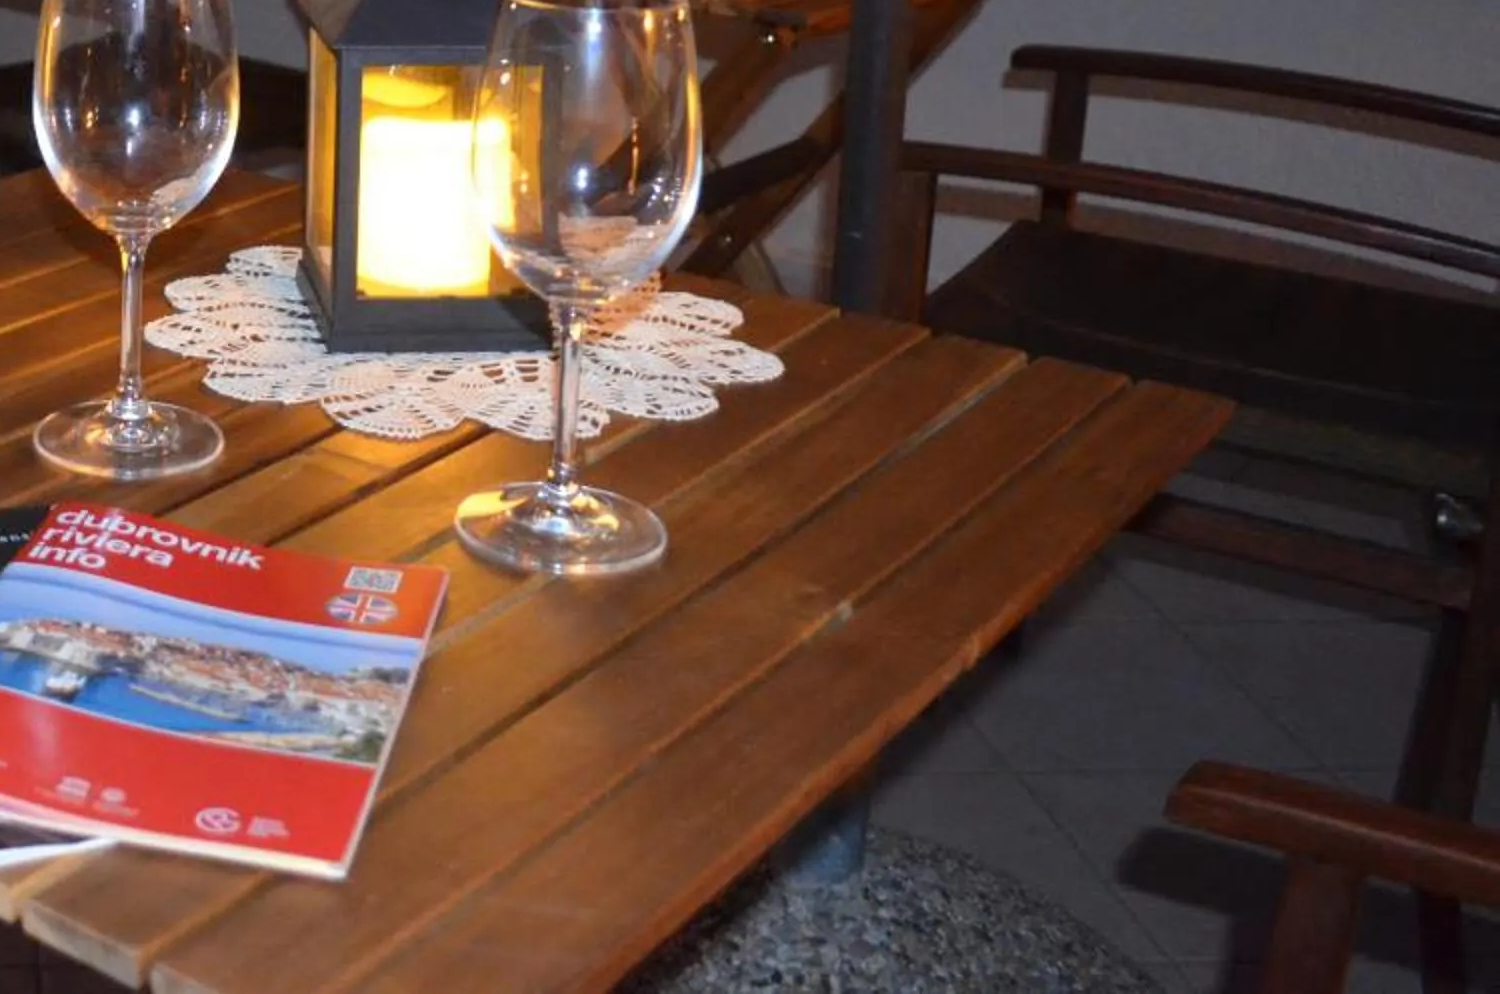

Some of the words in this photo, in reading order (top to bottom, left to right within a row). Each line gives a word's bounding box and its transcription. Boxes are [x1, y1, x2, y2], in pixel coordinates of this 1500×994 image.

[27, 542, 107, 568] info
[41, 526, 175, 568] riviera
[56, 509, 266, 571] dubrovnik
